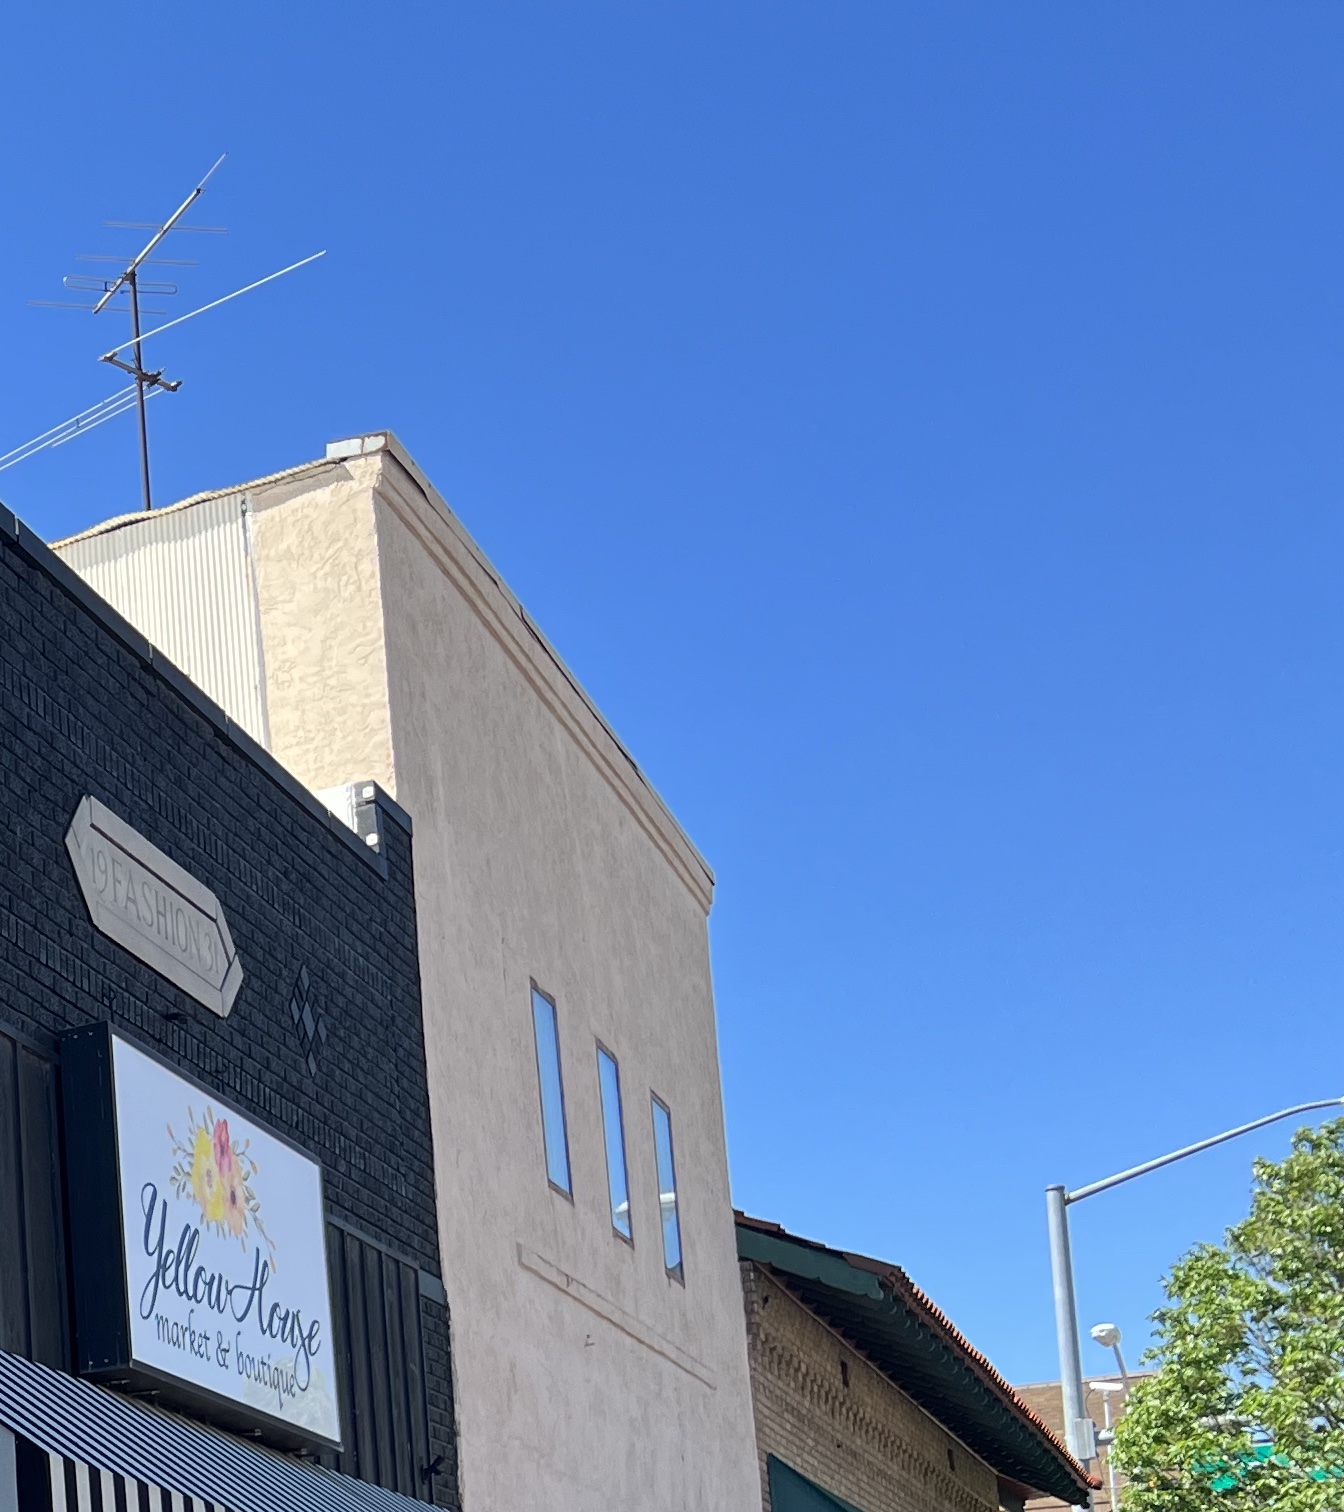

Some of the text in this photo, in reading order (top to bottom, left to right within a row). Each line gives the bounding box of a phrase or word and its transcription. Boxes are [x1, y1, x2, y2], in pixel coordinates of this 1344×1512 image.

[89, 846, 109, 894] 19
[111, 857, 203, 968] FASHION
[140, 1182, 321, 1392] Yellow House
[155, 1308, 296, 1411] market & boutique
